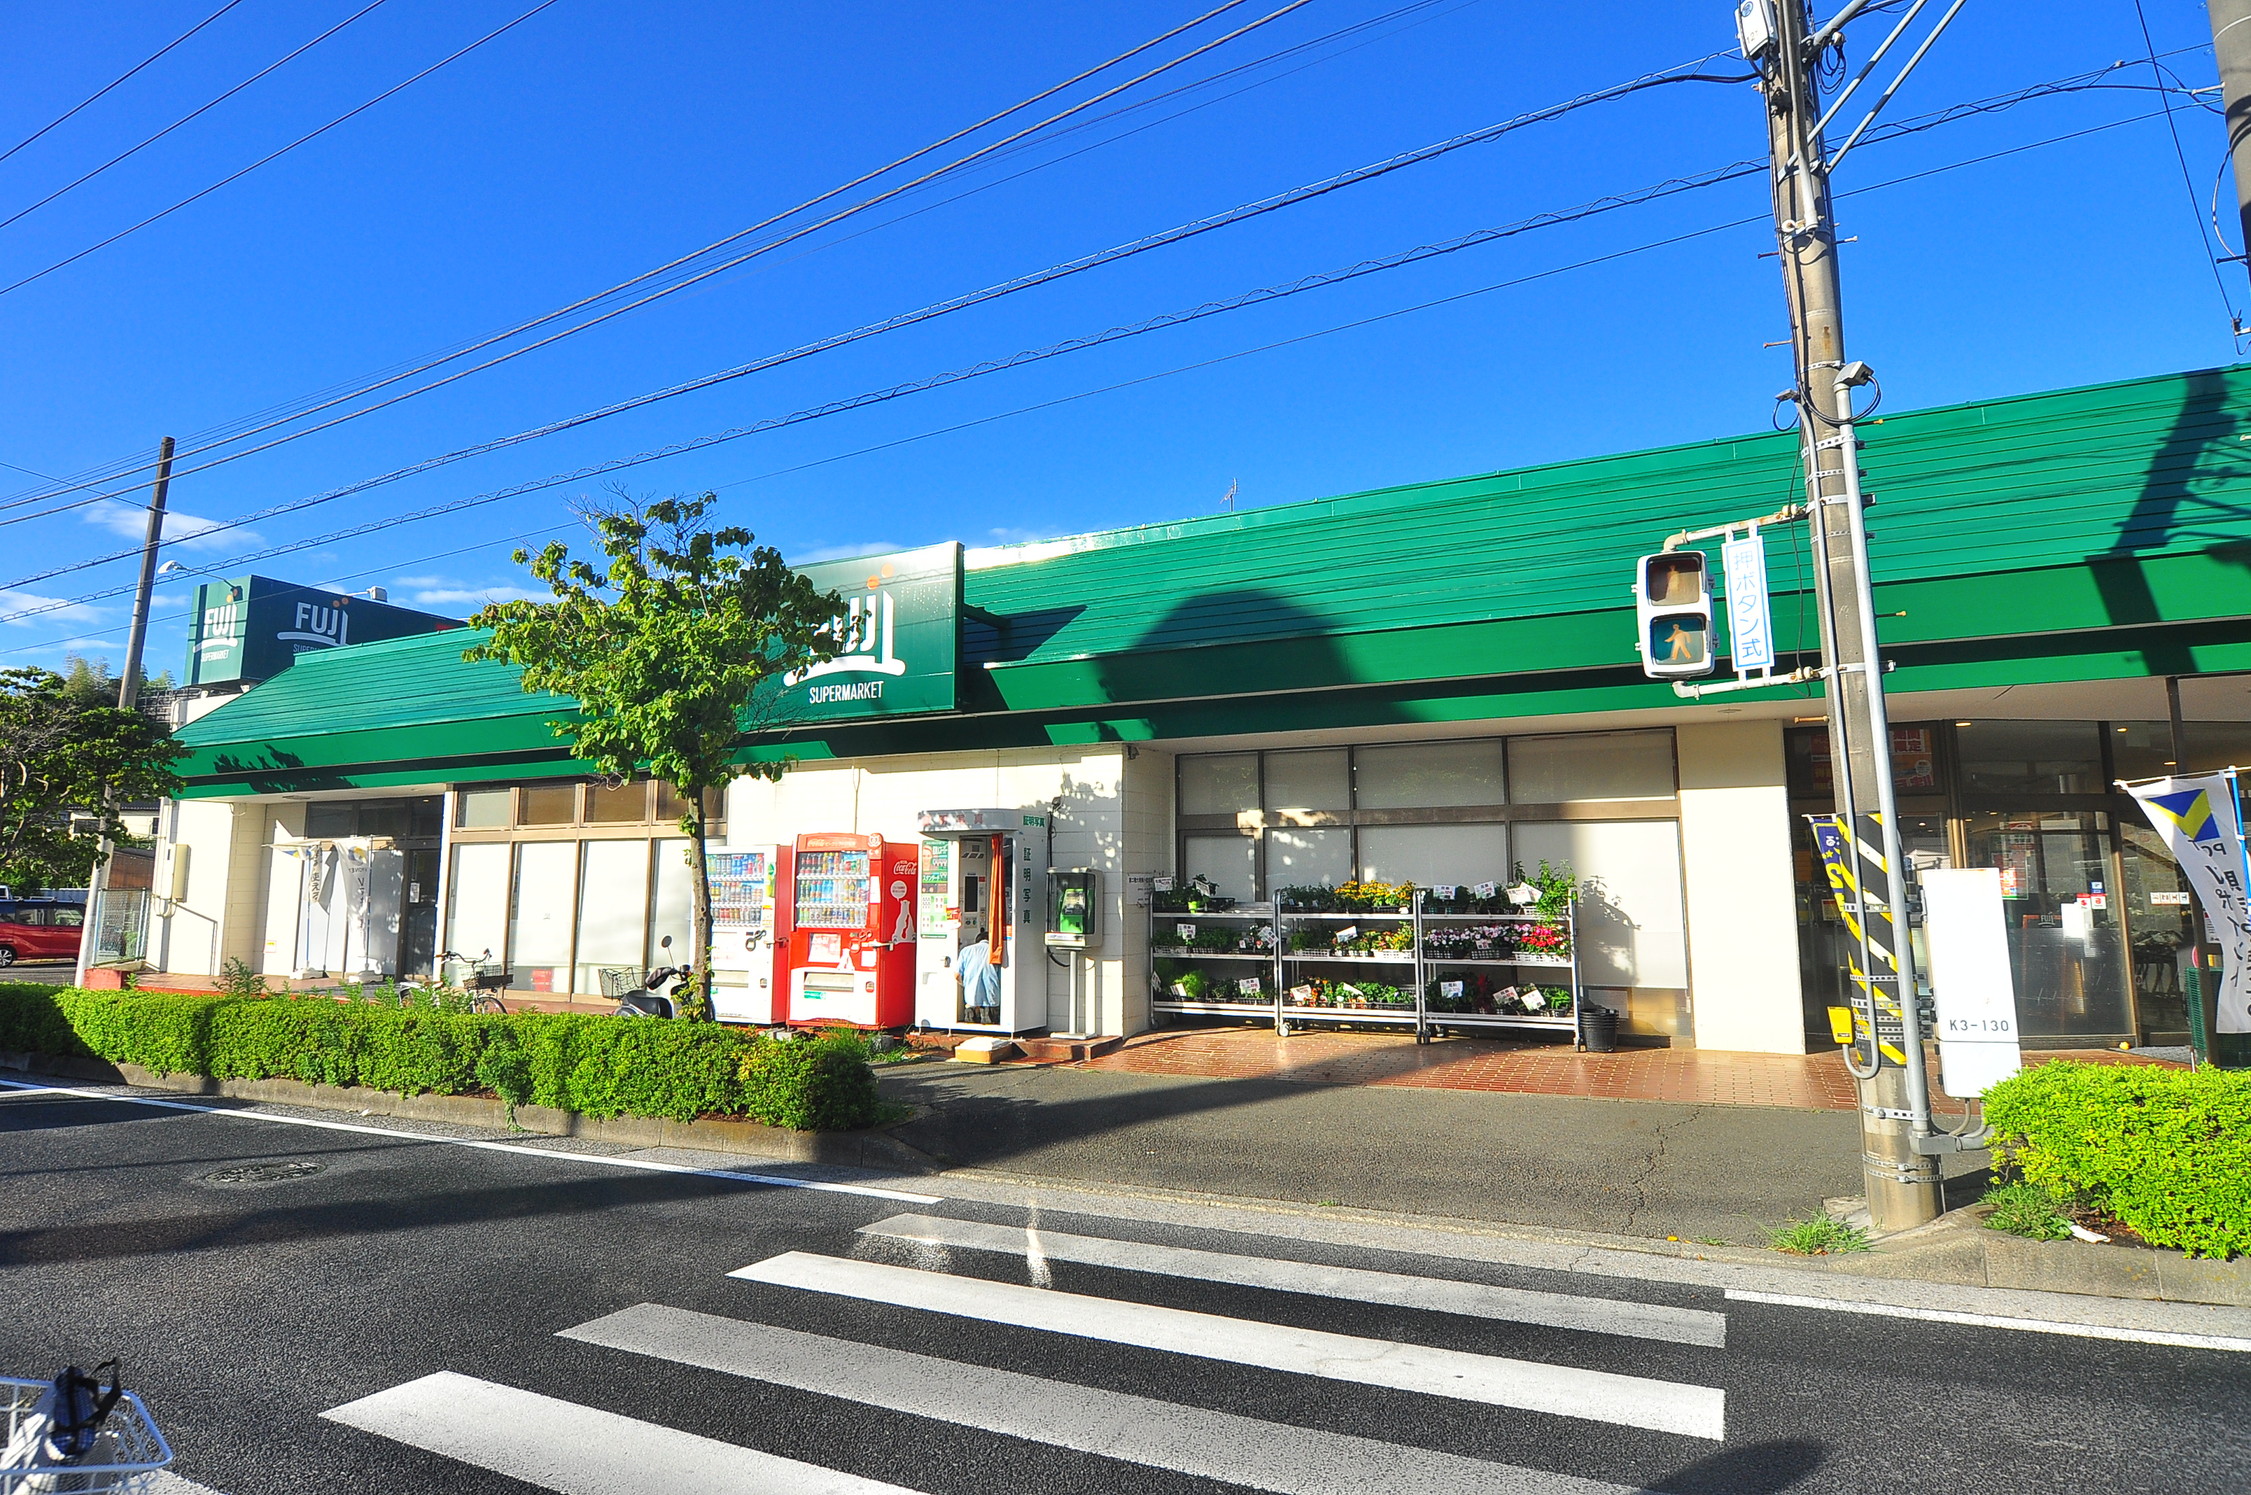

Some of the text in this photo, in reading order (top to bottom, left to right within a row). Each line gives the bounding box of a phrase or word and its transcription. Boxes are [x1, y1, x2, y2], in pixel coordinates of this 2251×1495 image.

[1734, 550, 1762, 658] 押ボタン式
[203, 603, 238, 640] FUJI
[296, 601, 349, 645] FUJI
[809, 681, 884, 704] SUPERMARKET
[1023, 815, 1045, 828] 証明写真
[893, 861, 918, 876] Coca-Cola
[1023, 847, 1031, 924] 証明写真
[1949, 1019, 2009, 1032] K3-130
